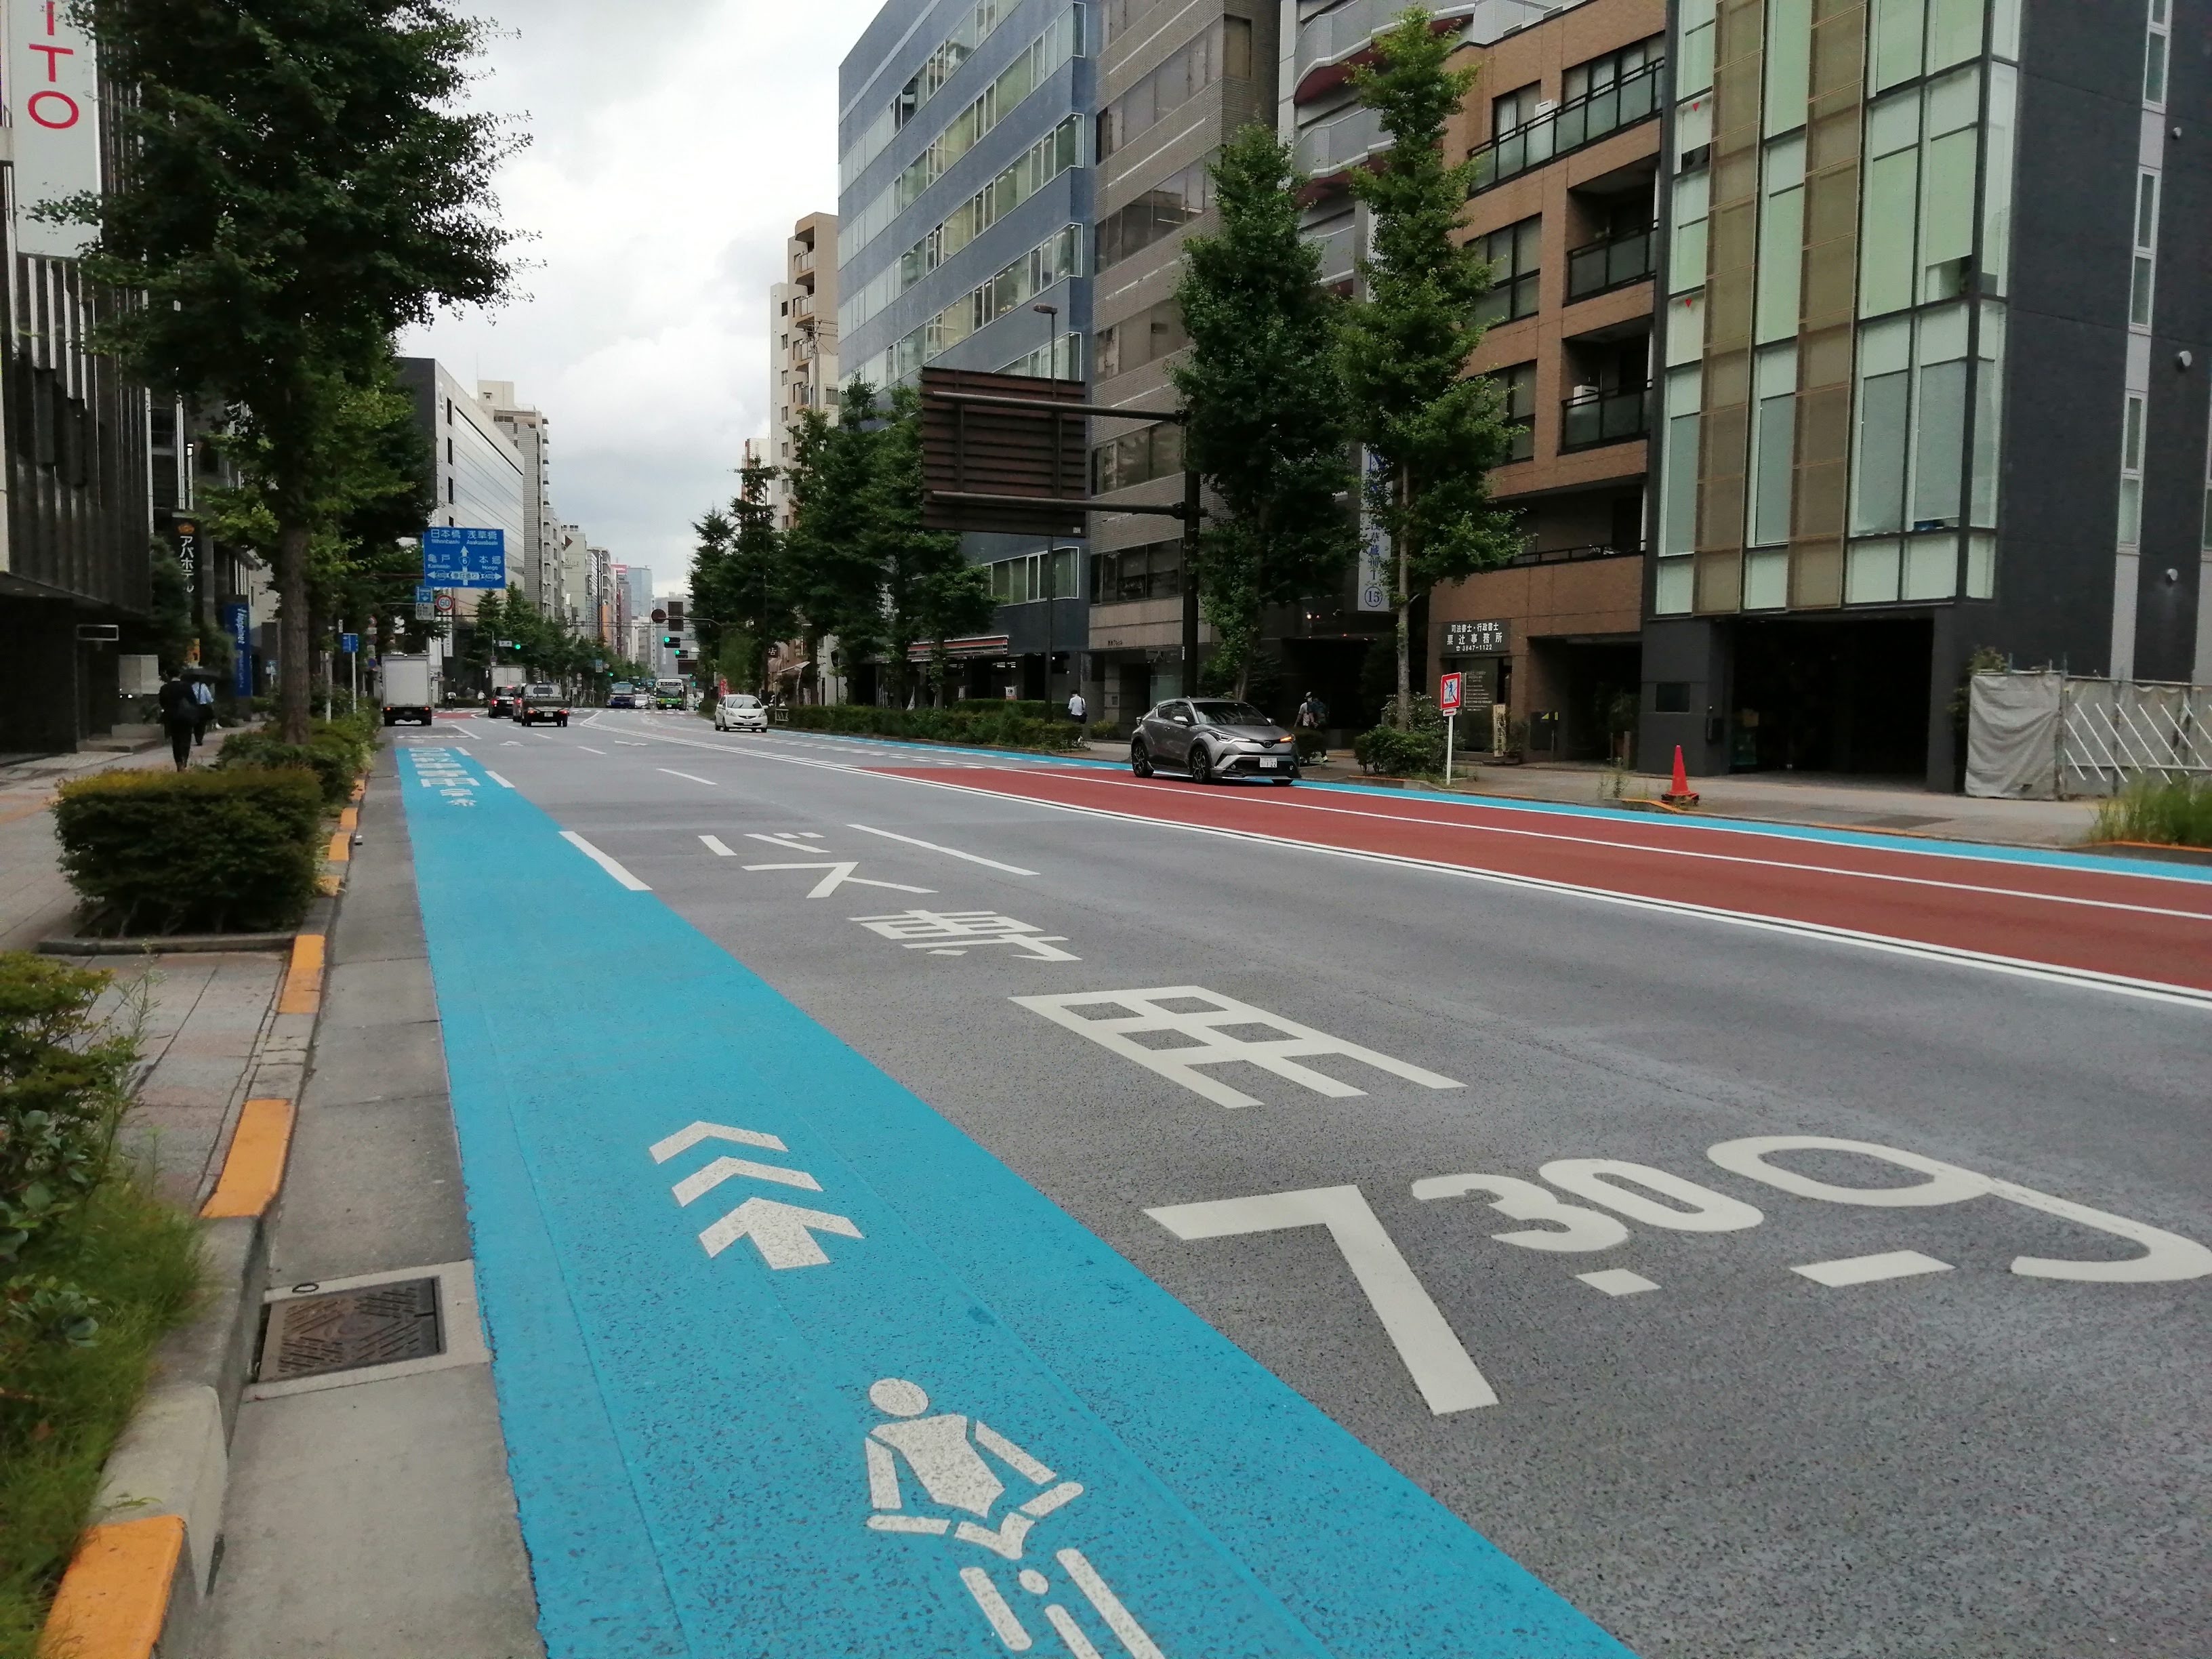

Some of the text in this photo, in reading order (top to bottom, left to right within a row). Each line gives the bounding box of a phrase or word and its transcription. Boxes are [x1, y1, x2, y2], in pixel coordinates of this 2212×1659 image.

[431, 529, 461, 539] 日本橋
[439, 598, 450, 607] 60
